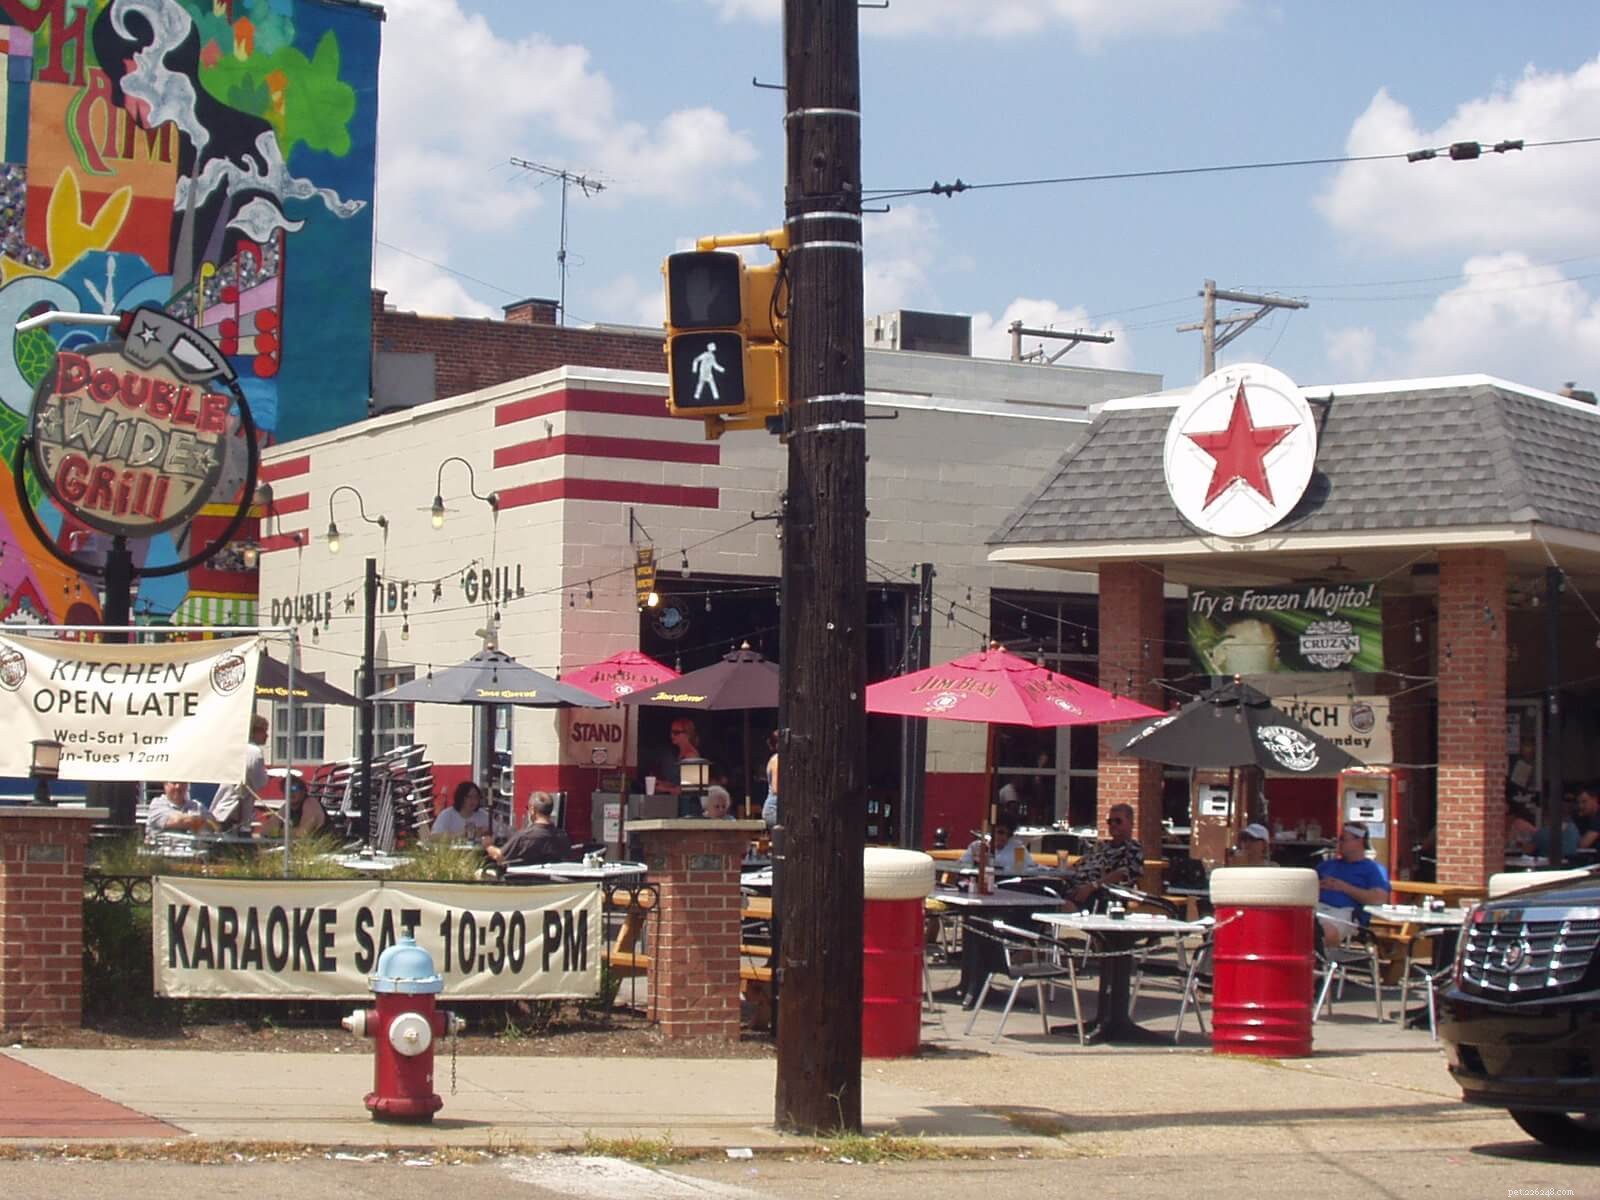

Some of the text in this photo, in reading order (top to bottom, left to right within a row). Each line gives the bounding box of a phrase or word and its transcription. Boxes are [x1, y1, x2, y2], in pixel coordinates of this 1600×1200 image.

[54, 351, 230, 434] DOUBLE
[63, 397, 203, 476] WIDE
[271, 564, 525, 626] DOUBLE IDE GRILL
[1192, 583, 1375, 619] Try a Frozen Mojito!
[50, 659, 189, 684] KITCHEN
[33, 688, 200, 717] OPEN LATE
[53, 729, 123, 744] Wed-Sat
[571, 722, 622, 743] STAND
[128, 751, 169, 763] 12am
[167, 904, 588, 976] KARAOKE SAT 10:30 PM
